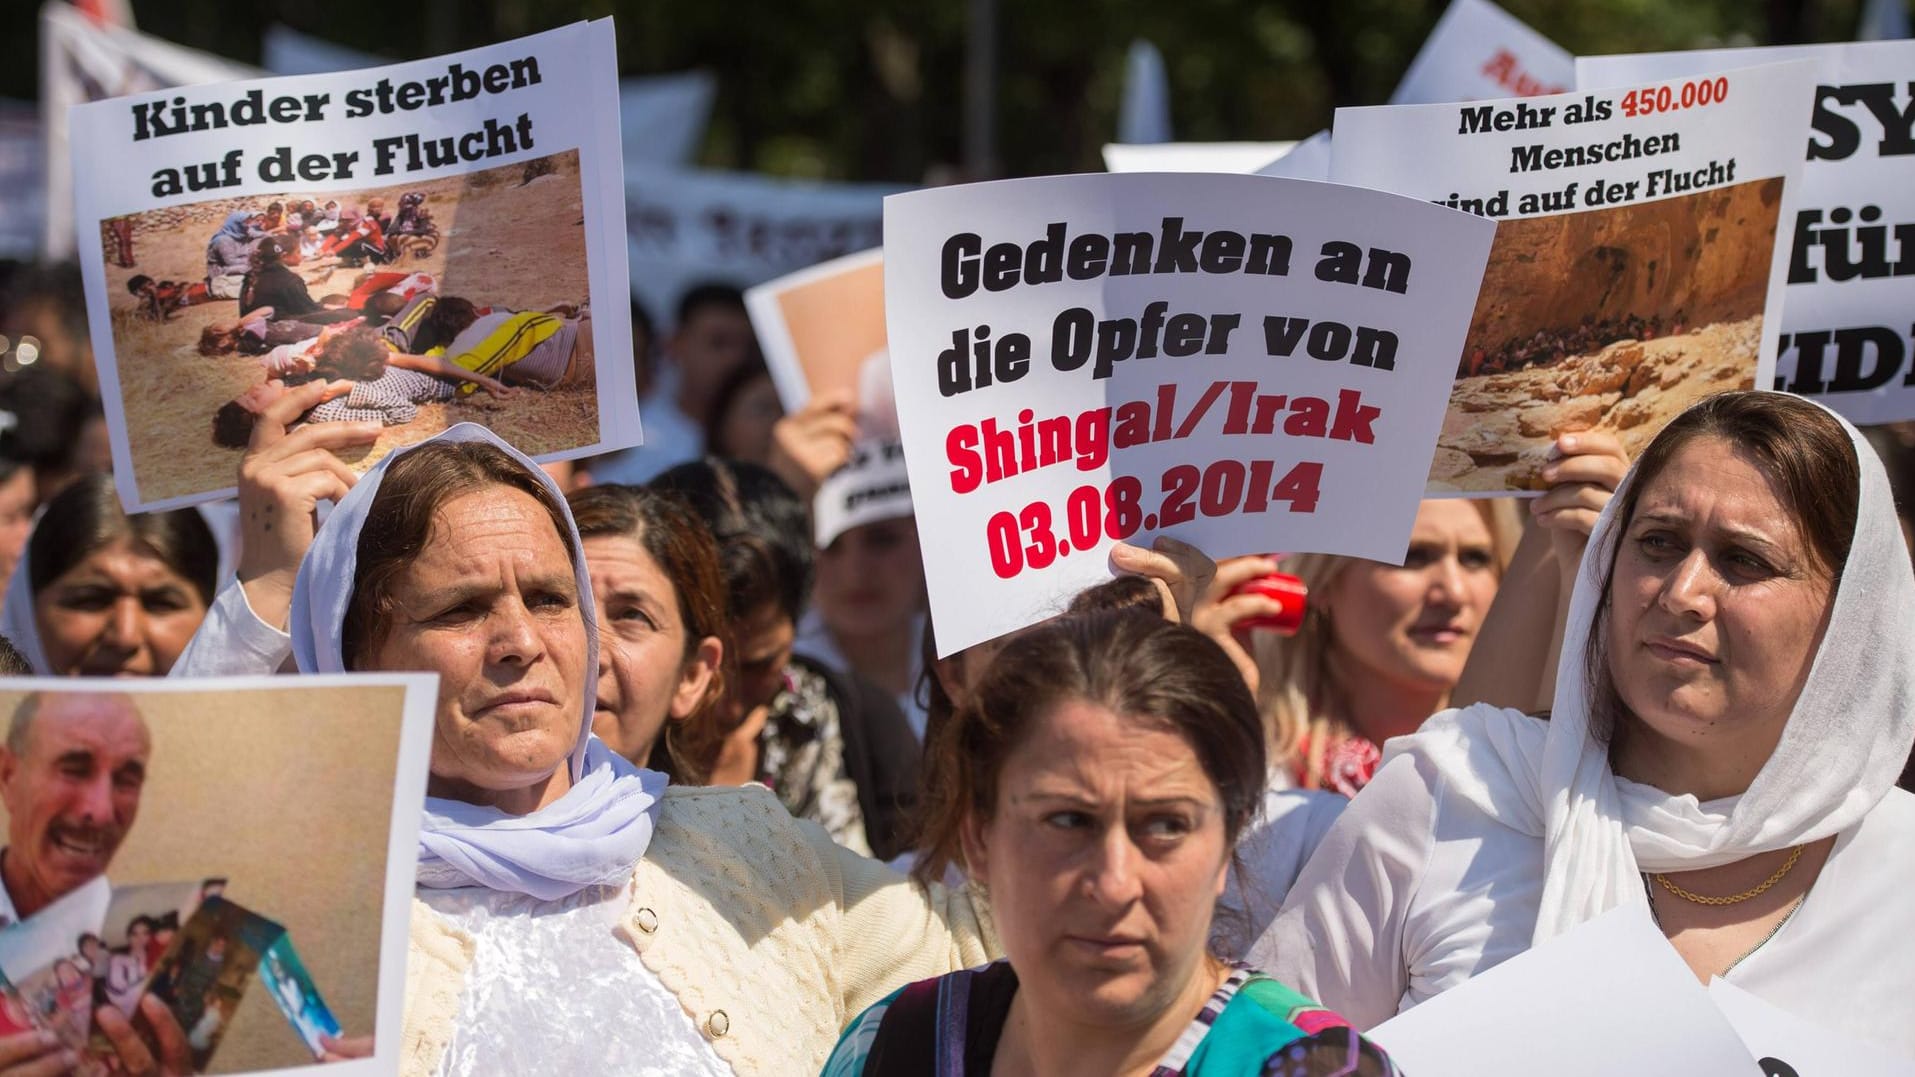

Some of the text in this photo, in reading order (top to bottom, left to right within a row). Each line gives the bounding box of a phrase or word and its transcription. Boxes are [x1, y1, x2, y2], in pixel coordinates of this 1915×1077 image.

[132, 55, 542, 142] Kinder sterben
[1458, 76, 1729, 135] Mehr als 450.000
[151, 113, 533, 198] auf der Flucht
[1431, 158, 1736, 217] ind auf der Flucht
[1509, 132, 1680, 173] Menschen
[941, 216, 1293, 300] Gedenken
[1314, 240, 1412, 295] an
[937, 301, 1399, 397] die Opfer von
[946, 381, 1381, 495] Shingal/Irak
[986, 459, 1323, 579] 03.08.2014
